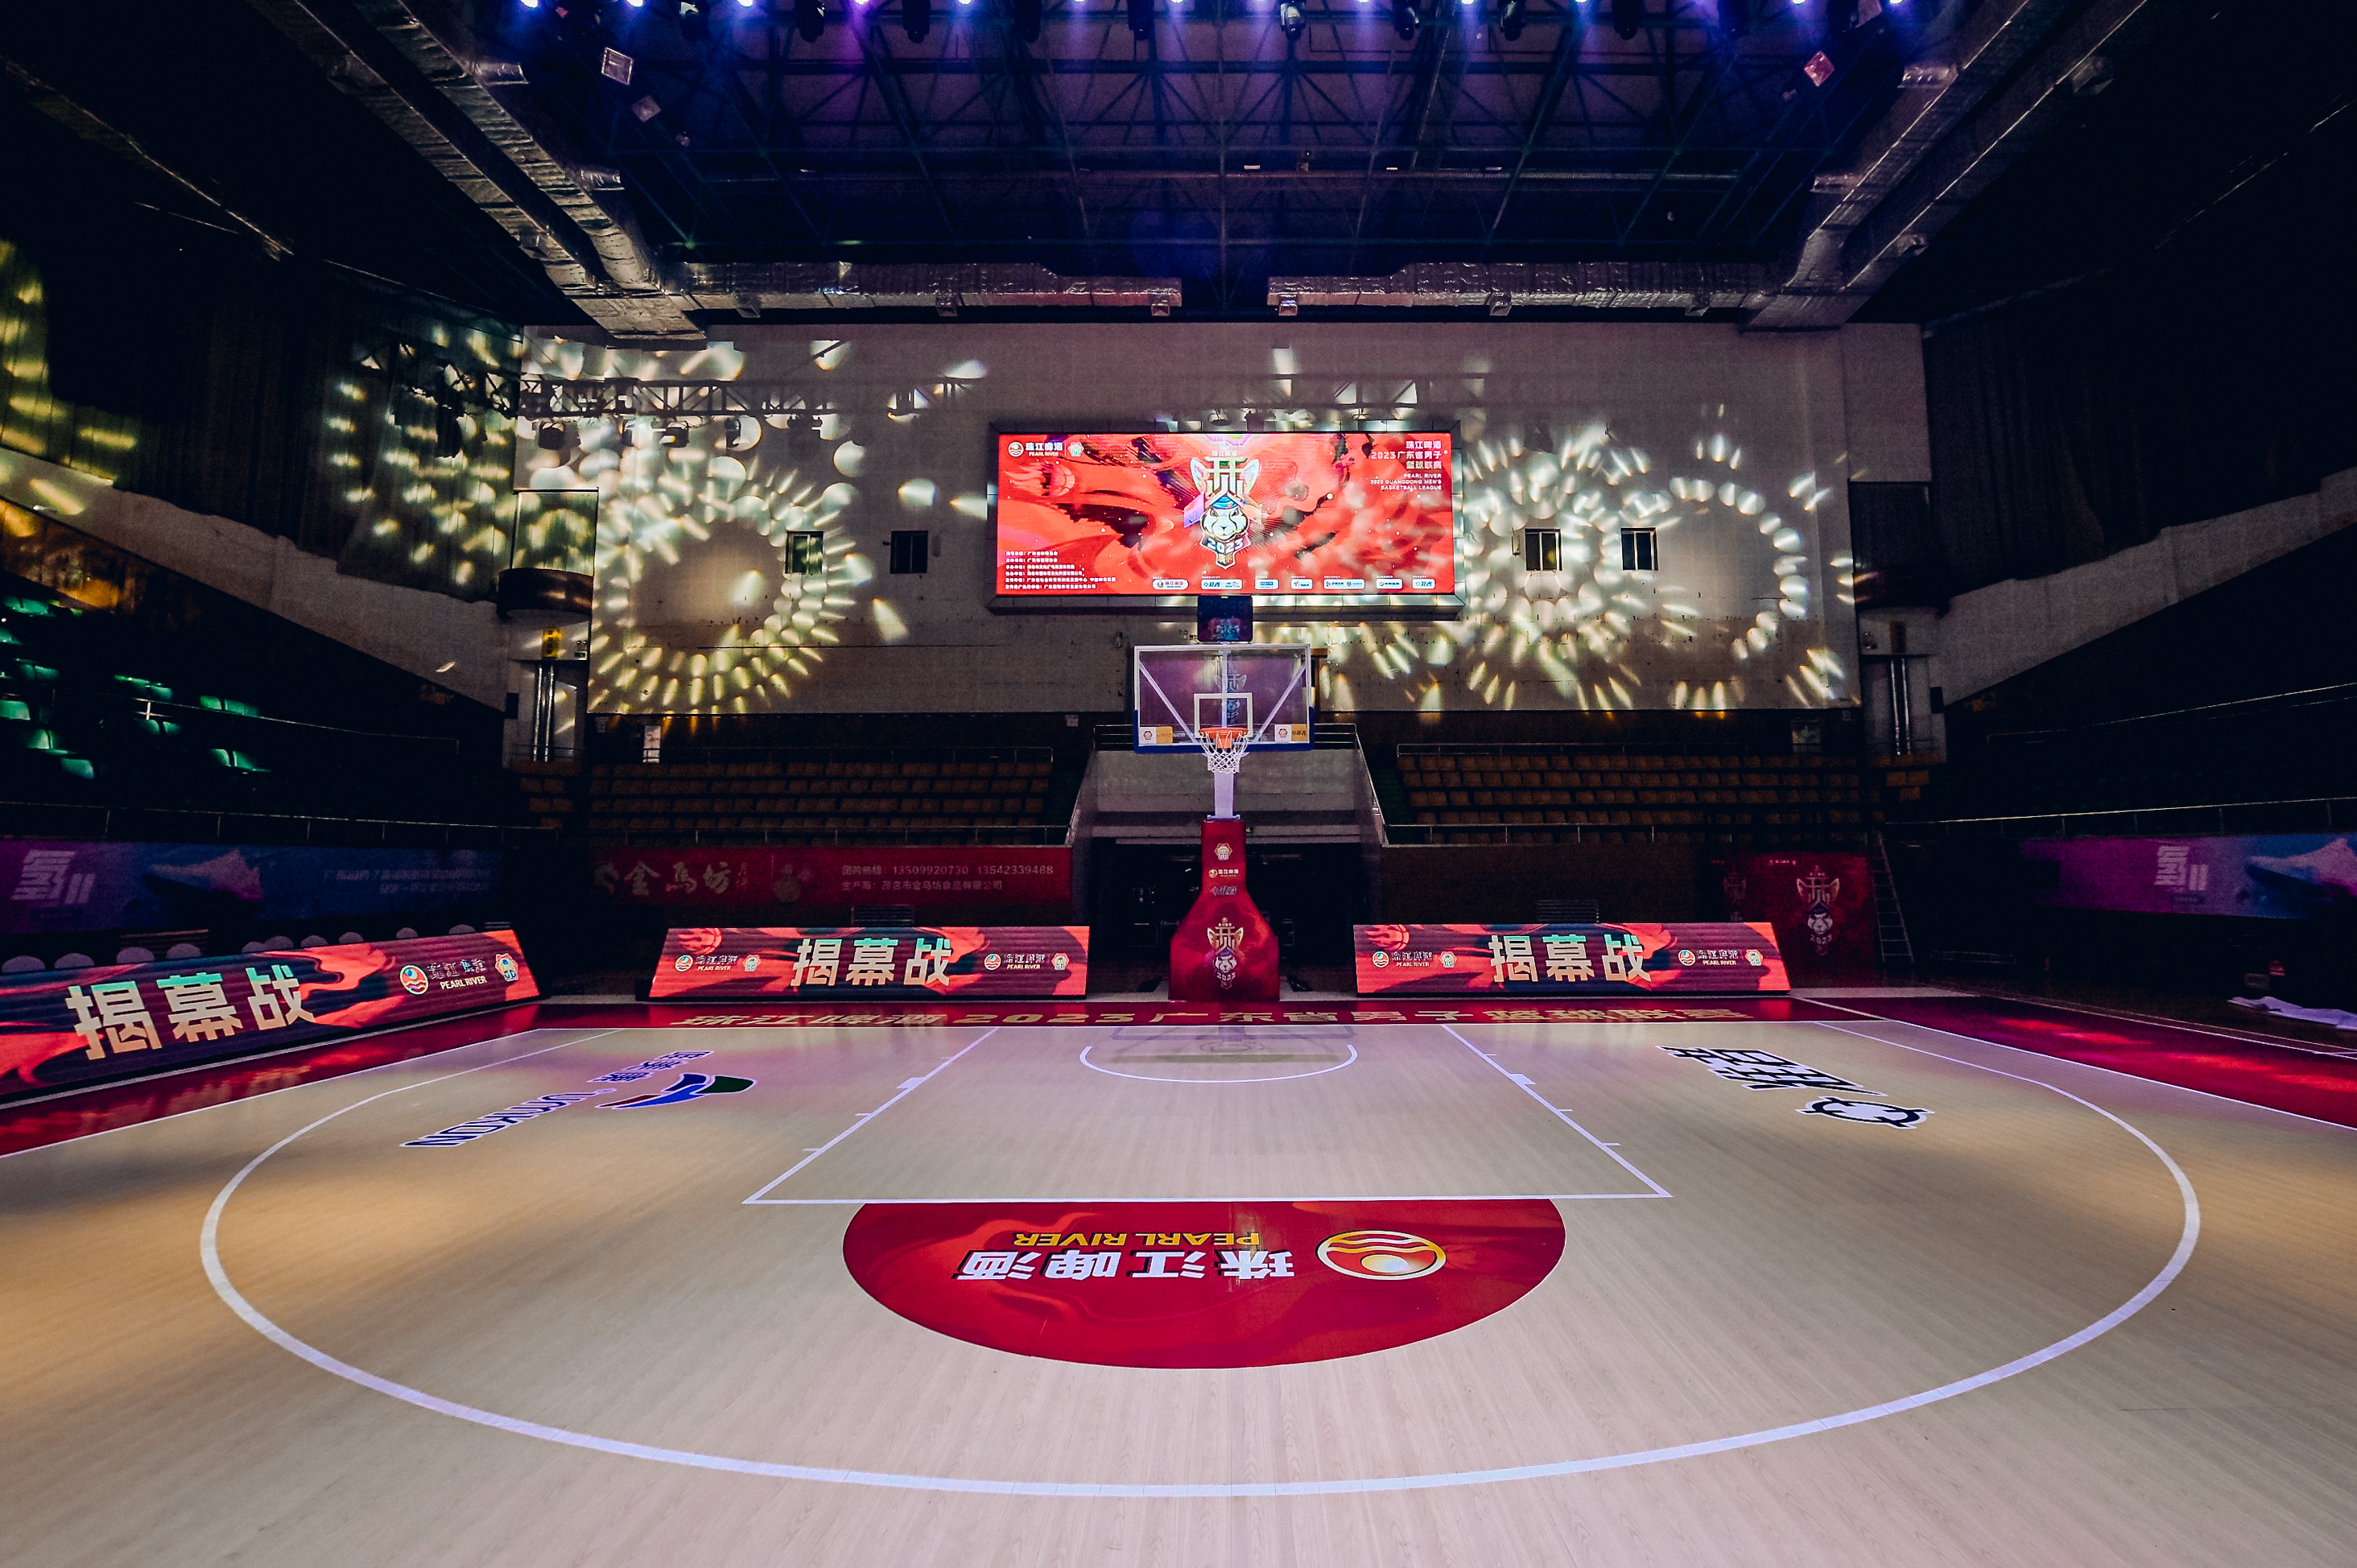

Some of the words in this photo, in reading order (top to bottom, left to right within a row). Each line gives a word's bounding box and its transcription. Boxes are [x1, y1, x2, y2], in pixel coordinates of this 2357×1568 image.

[1207, 537, 1244, 554] 2023
[790, 937, 951, 986] 揭幕战
[1488, 934, 1652, 982] 揭幕战
[440, 979, 465, 991] PEARL
[465, 975, 488, 988] RIVER
[65, 964, 316, 1060] 揭幕战
[1013, 1232, 1126, 1248] RIVER
[1135, 1232, 1261, 1247] PEARL
[957, 1248, 1295, 1281] 珠江啤酒
